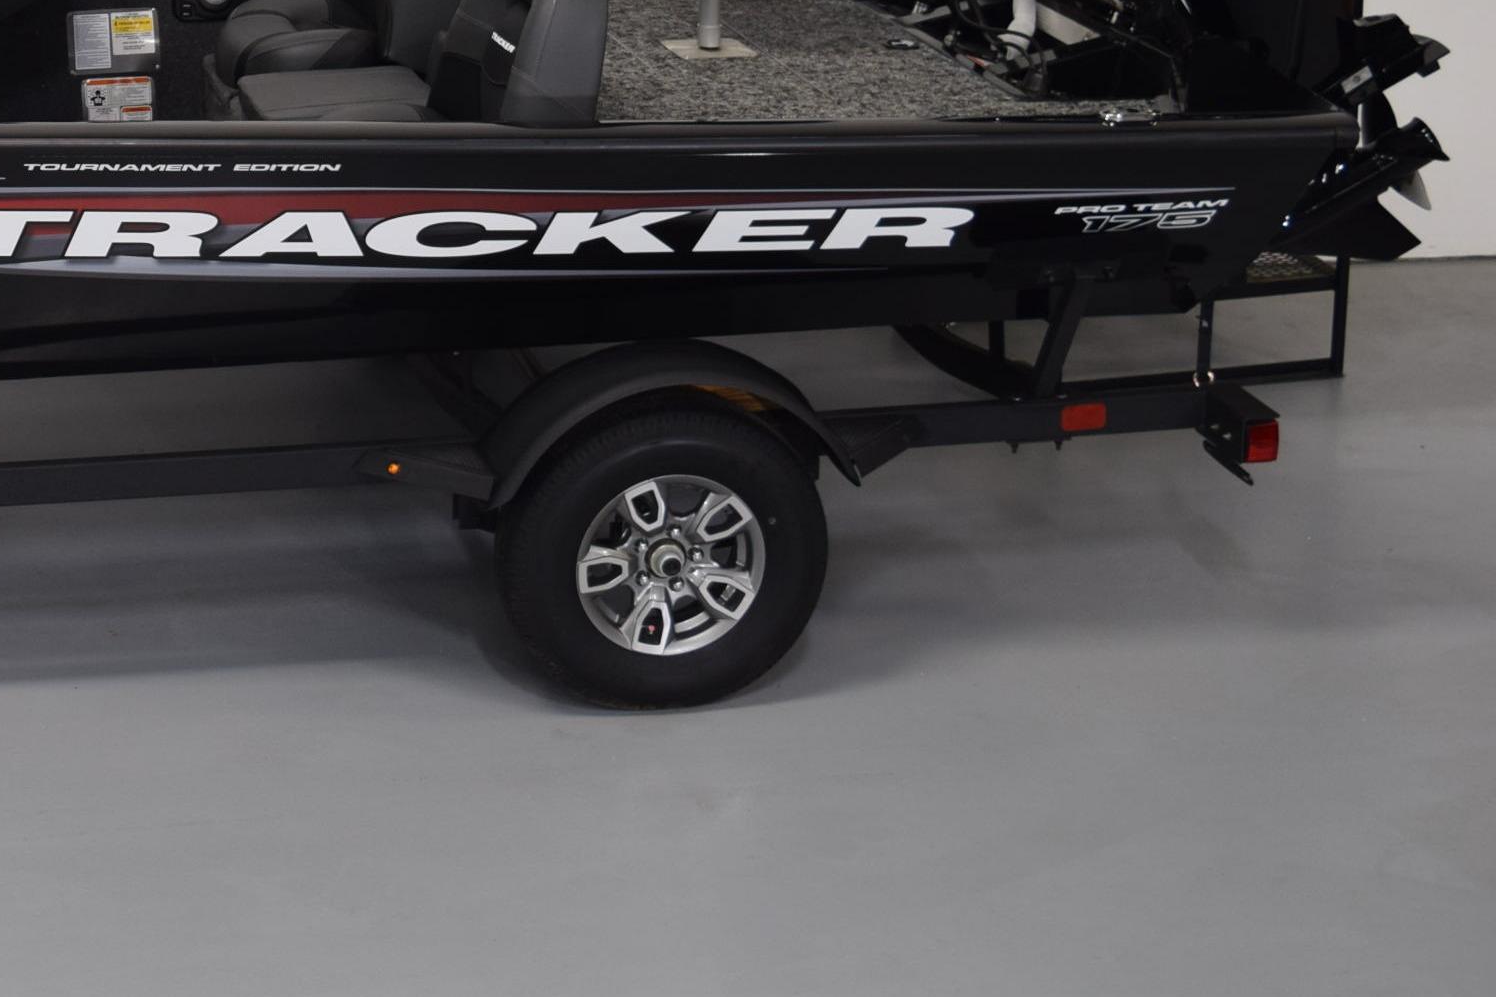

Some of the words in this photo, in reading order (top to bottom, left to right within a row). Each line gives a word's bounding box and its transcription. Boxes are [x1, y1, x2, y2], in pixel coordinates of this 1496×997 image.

[23, 162, 222, 173] TOURNAMENT
[233, 162, 342, 172] EDITION
[1054, 204, 1126, 215] PRO
[1133, 199, 1230, 211] TEAM
[1081, 209, 1217, 233] 175
